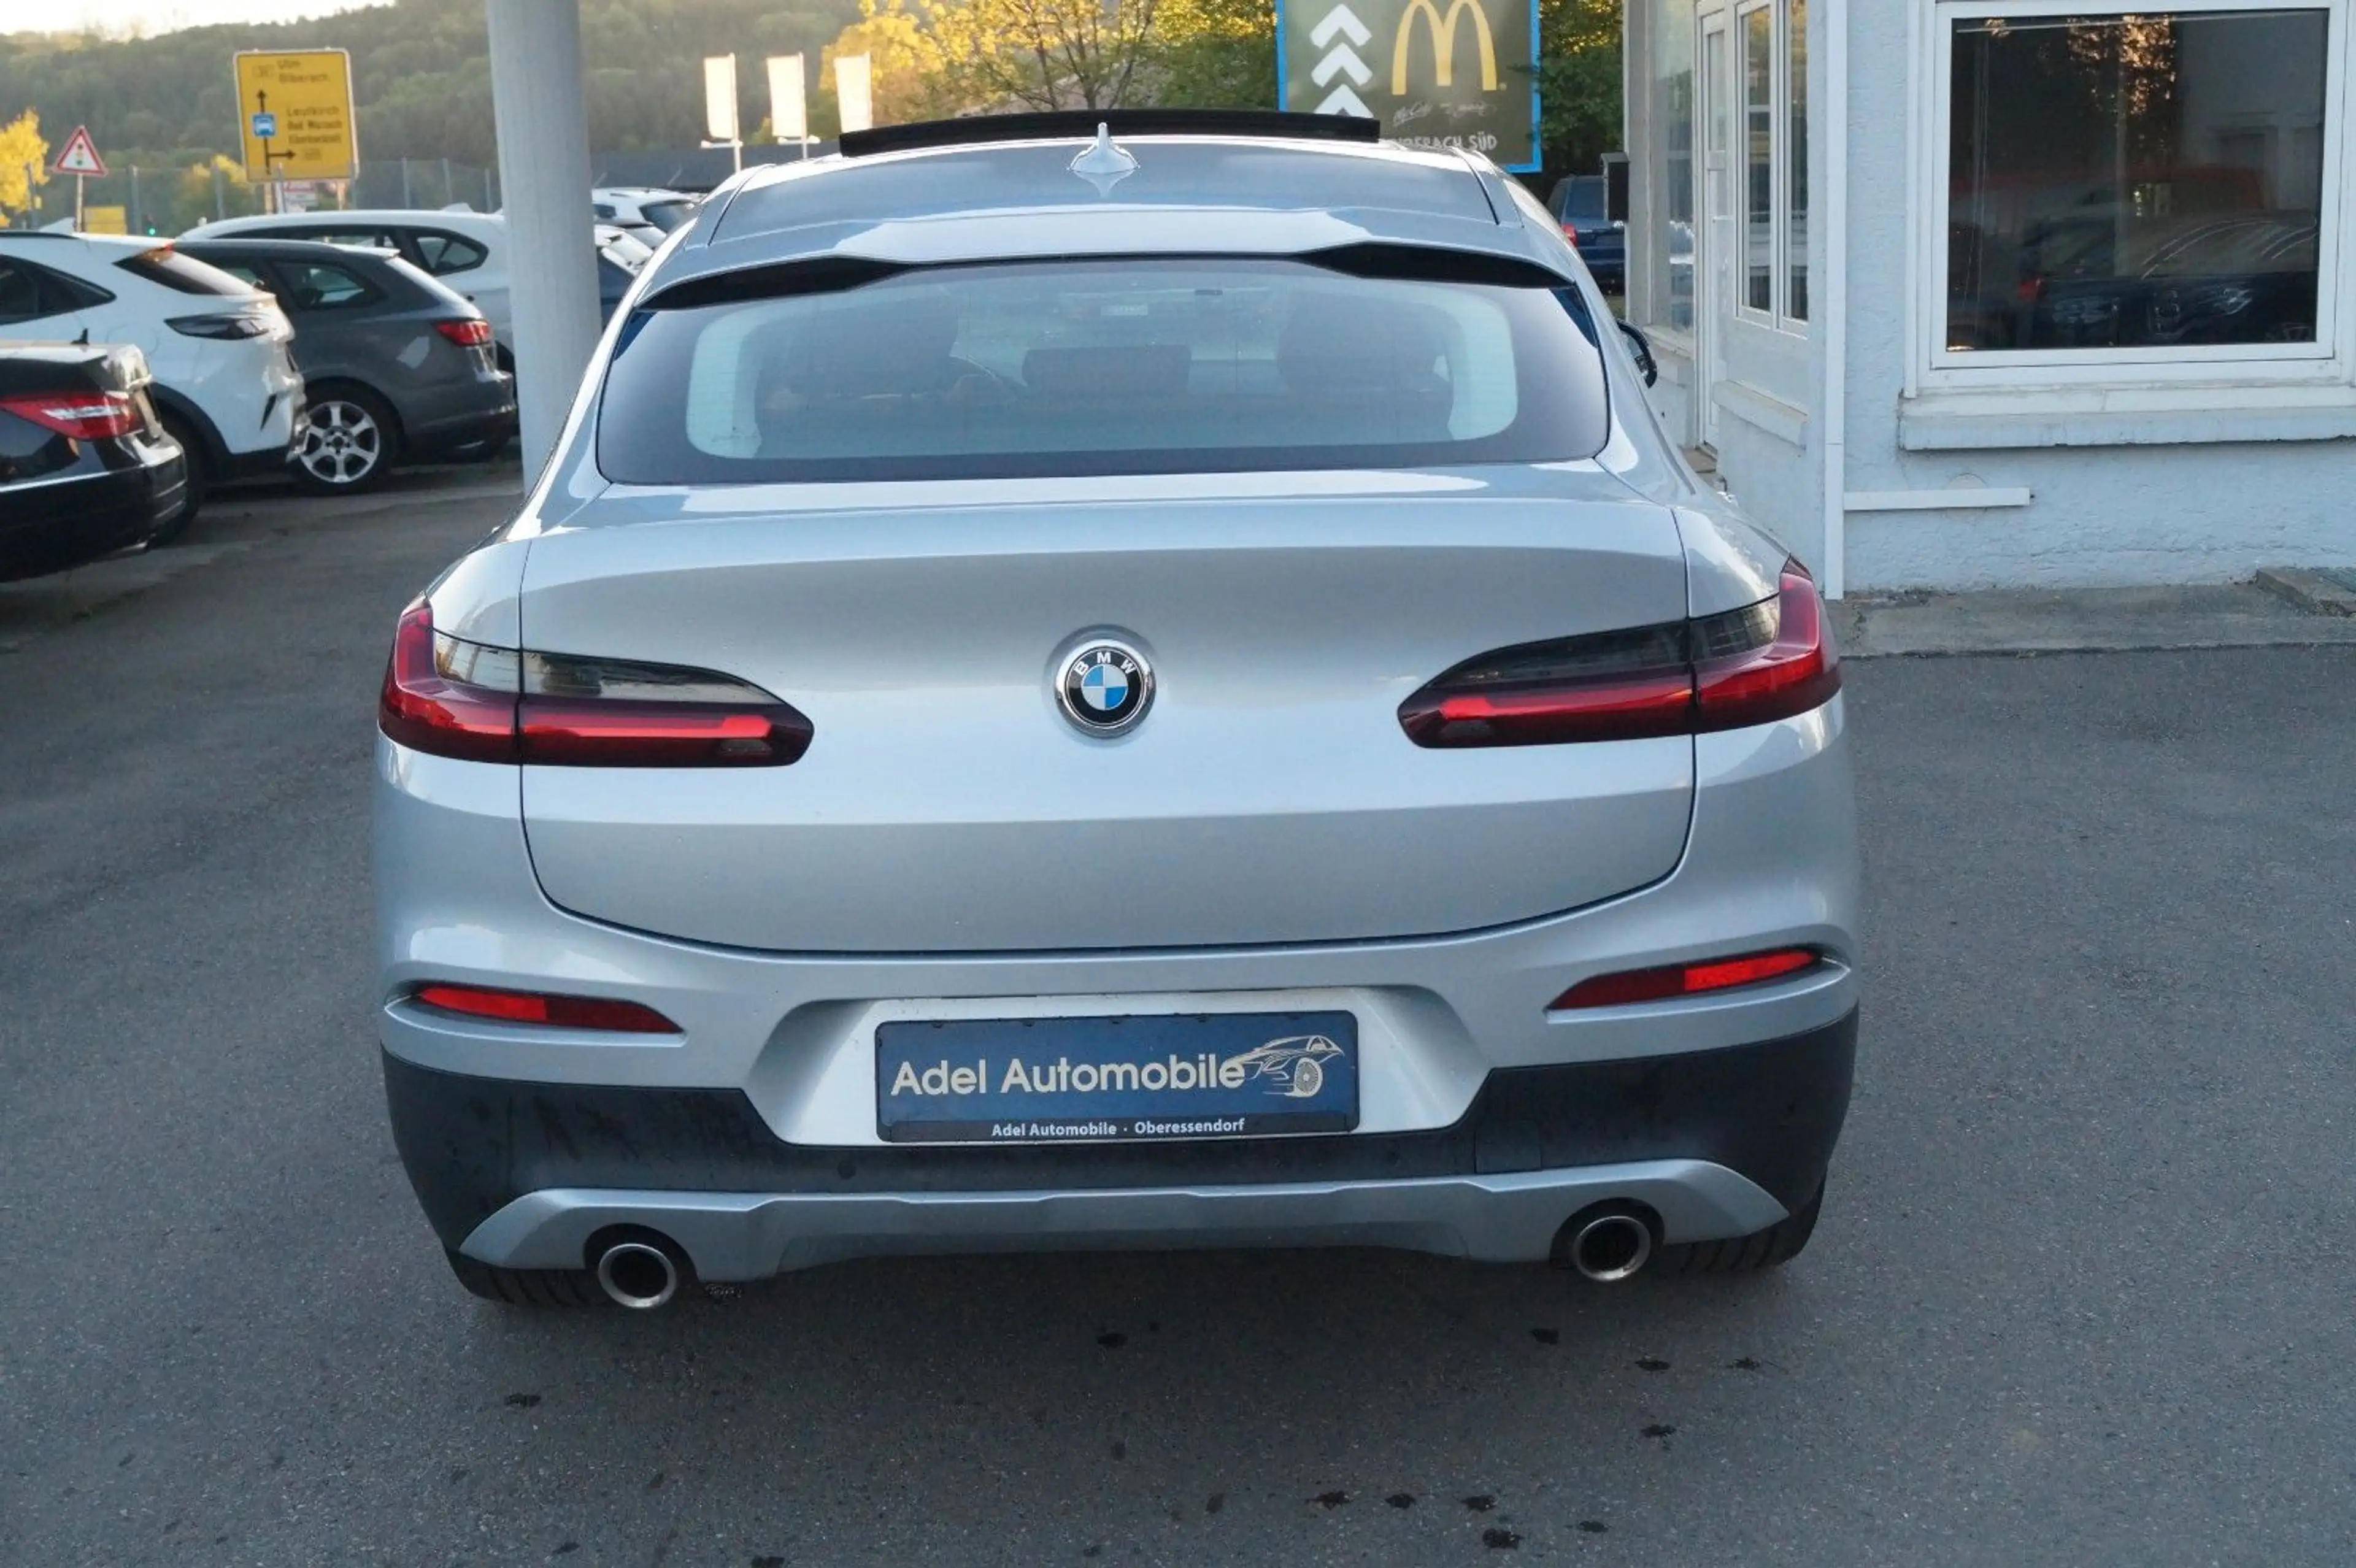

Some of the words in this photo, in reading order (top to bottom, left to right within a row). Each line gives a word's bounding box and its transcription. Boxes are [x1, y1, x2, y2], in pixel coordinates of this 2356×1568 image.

[1469, 131, 1497, 151] SÜD
[1074, 651, 1137, 675] BMW
[890, 1059, 987, 1096] Adel
[1000, 1053, 1245, 1094] Automobile
[991, 1123, 1026, 1136] Adel
[1029, 1121, 1117, 1136] Automobile
[1134, 1117, 1245, 1134] Oberessendorf
